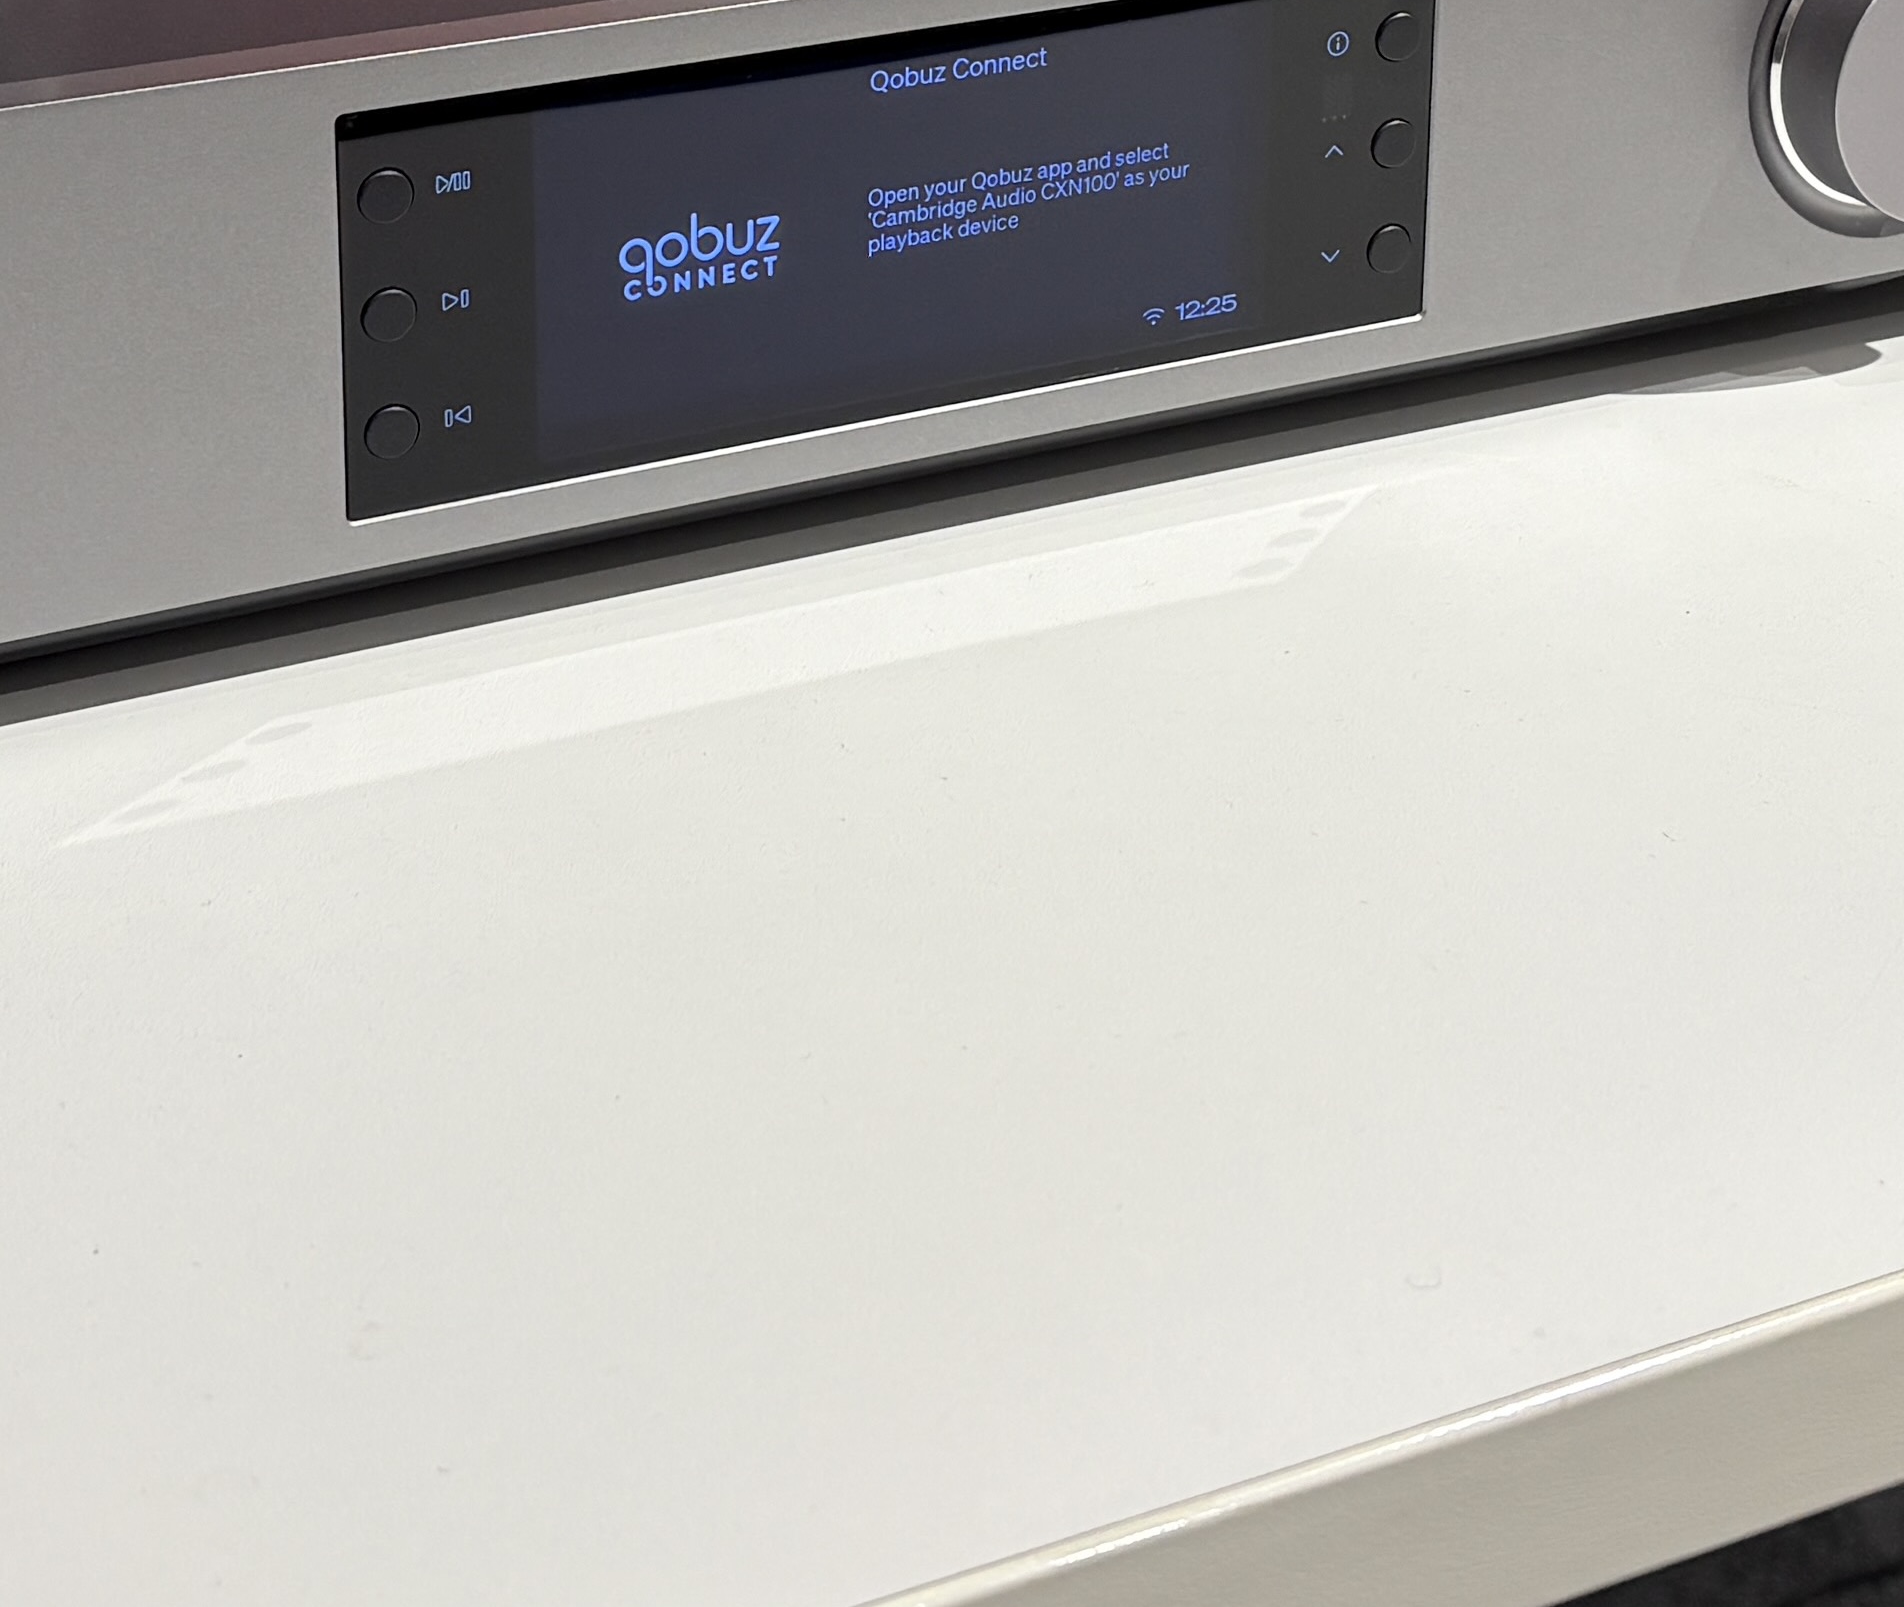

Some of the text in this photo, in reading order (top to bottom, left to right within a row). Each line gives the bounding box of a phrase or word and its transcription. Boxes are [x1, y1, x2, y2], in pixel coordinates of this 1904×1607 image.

[869, 47, 1049, 95] Qobuz Connect
[867, 142, 1170, 213] Open your Qobuz app and select
[981, 185, 1037, 213] Audio
[1040, 172, 1121, 202] CXN100'
[1122, 170, 1146, 188] as
[1148, 160, 1191, 190] your
[618, 212, 781, 287] qobuz
[867, 211, 1020, 258] playback device
[623, 255, 779, 302] CONNECT
[1174, 292, 1238, 321] 12:25
